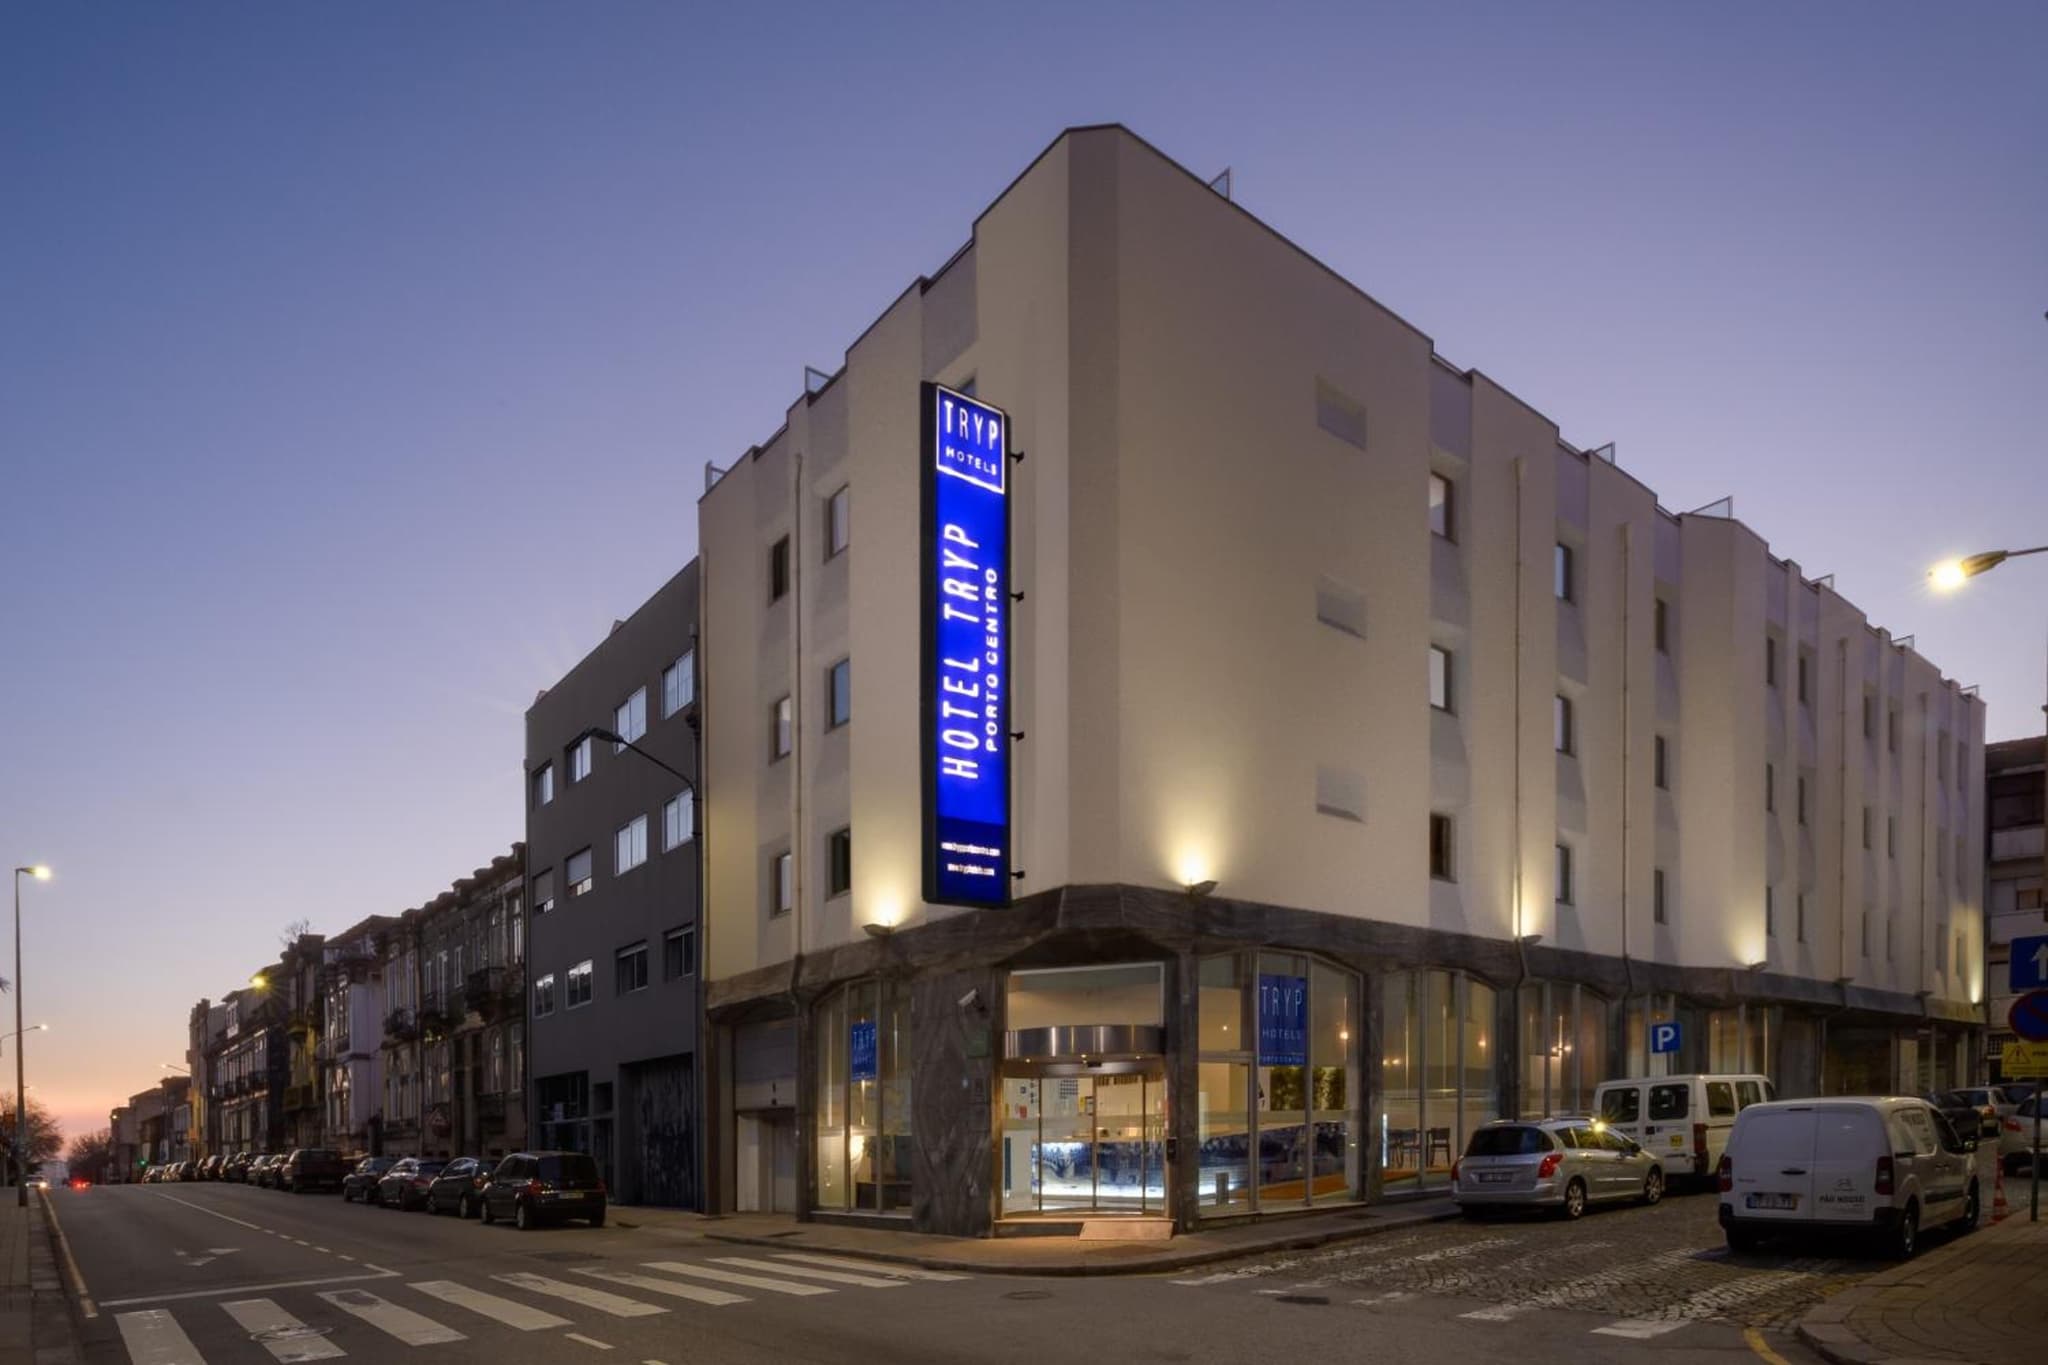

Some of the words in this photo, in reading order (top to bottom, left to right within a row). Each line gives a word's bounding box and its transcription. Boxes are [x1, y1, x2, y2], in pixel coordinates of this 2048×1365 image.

[944, 400, 998, 450] TRYP
[945, 445, 997, 475] HOTELS
[943, 523, 979, 622] TRYP
[985, 568, 998, 665] CENTRO
[942, 658, 979, 779] HOTEL
[985, 674, 998, 752] PORTO
[1261, 986, 1303, 1016] TRYP
[1658, 1026, 1675, 1051] P
